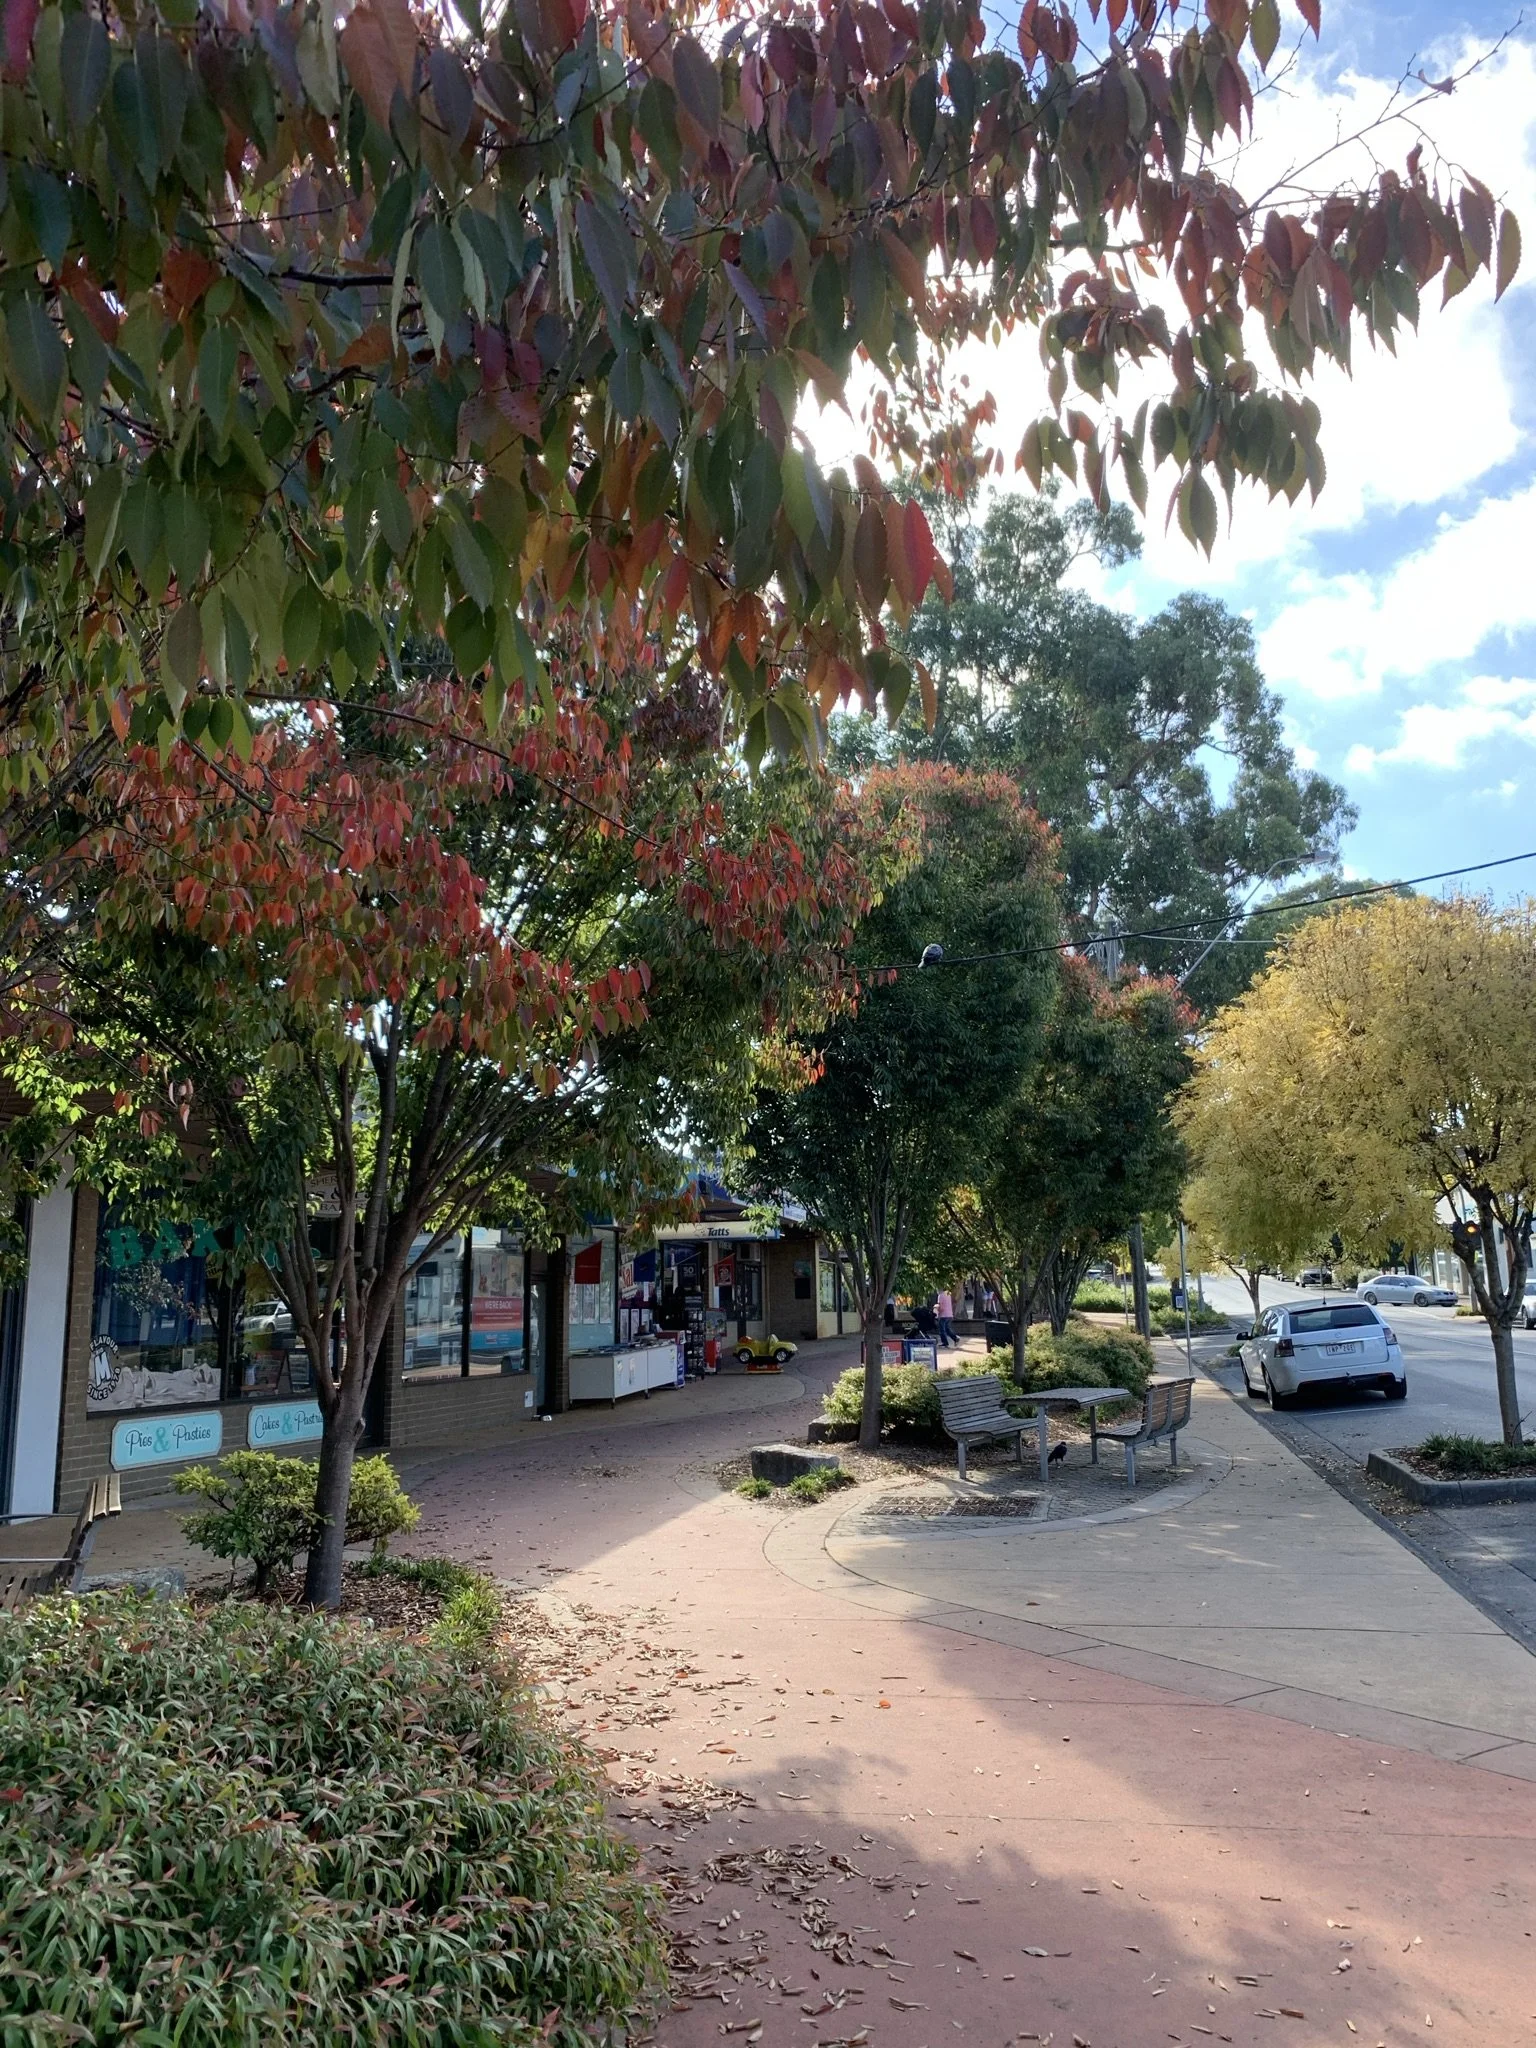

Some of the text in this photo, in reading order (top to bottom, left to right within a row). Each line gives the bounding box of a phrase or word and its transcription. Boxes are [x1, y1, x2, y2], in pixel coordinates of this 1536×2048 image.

[707, 1227, 730, 1237] Tatts
[90, 1335, 119, 1354] FLAVOUR
[87, 1384, 108, 1400] SINCE
[255, 1414, 280, 1439] Cakes
[282, 1411, 293, 1435] &
[125, 1424, 211, 1456] Pies & Pasties
